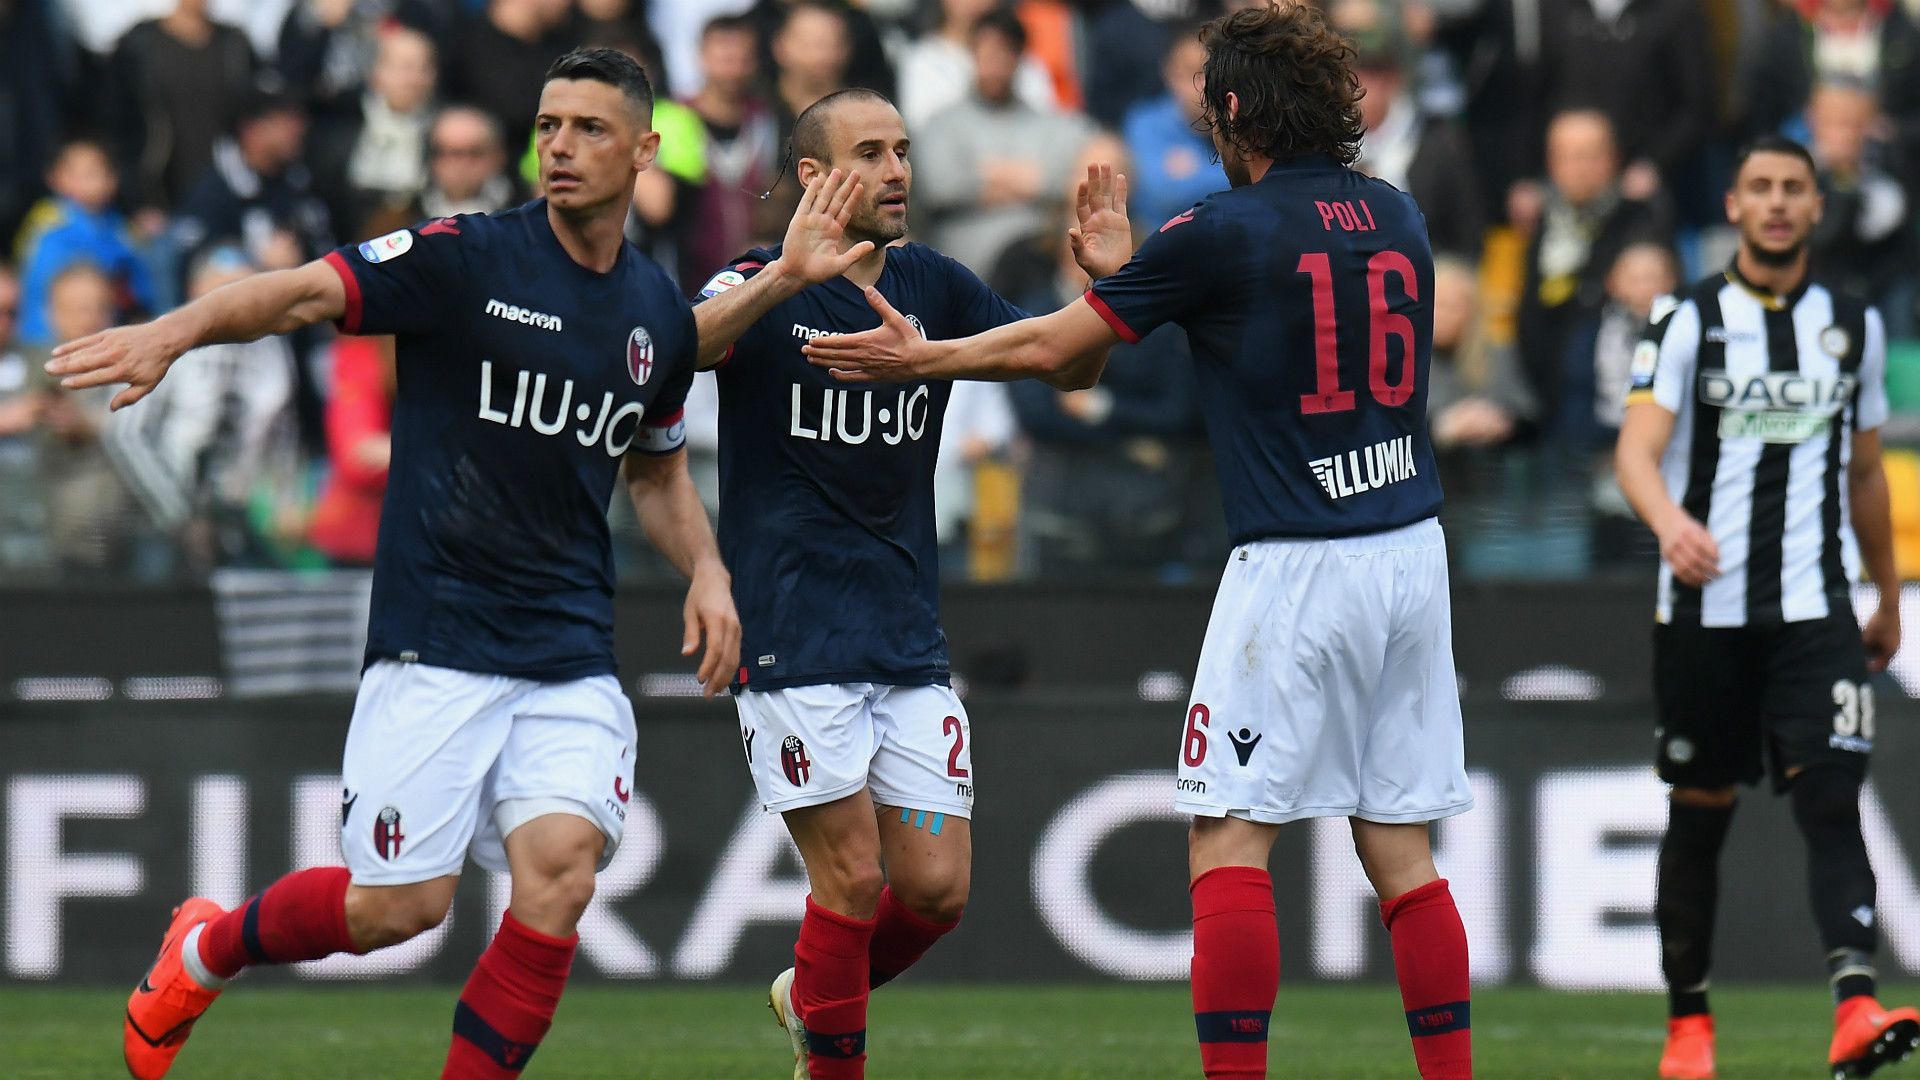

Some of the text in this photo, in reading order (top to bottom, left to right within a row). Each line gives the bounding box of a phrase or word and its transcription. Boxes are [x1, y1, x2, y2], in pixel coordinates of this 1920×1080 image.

[1314, 199, 1377, 231] POLI
[485, 298, 563, 332] macron
[1296, 250, 1419, 415] 16
[1308, 435, 1418, 500] ILLUMIA
[784, 736, 800, 749] BFC
[1177, 777, 1206, 794] cron
[1030, 768, 1672, 990] CHE
